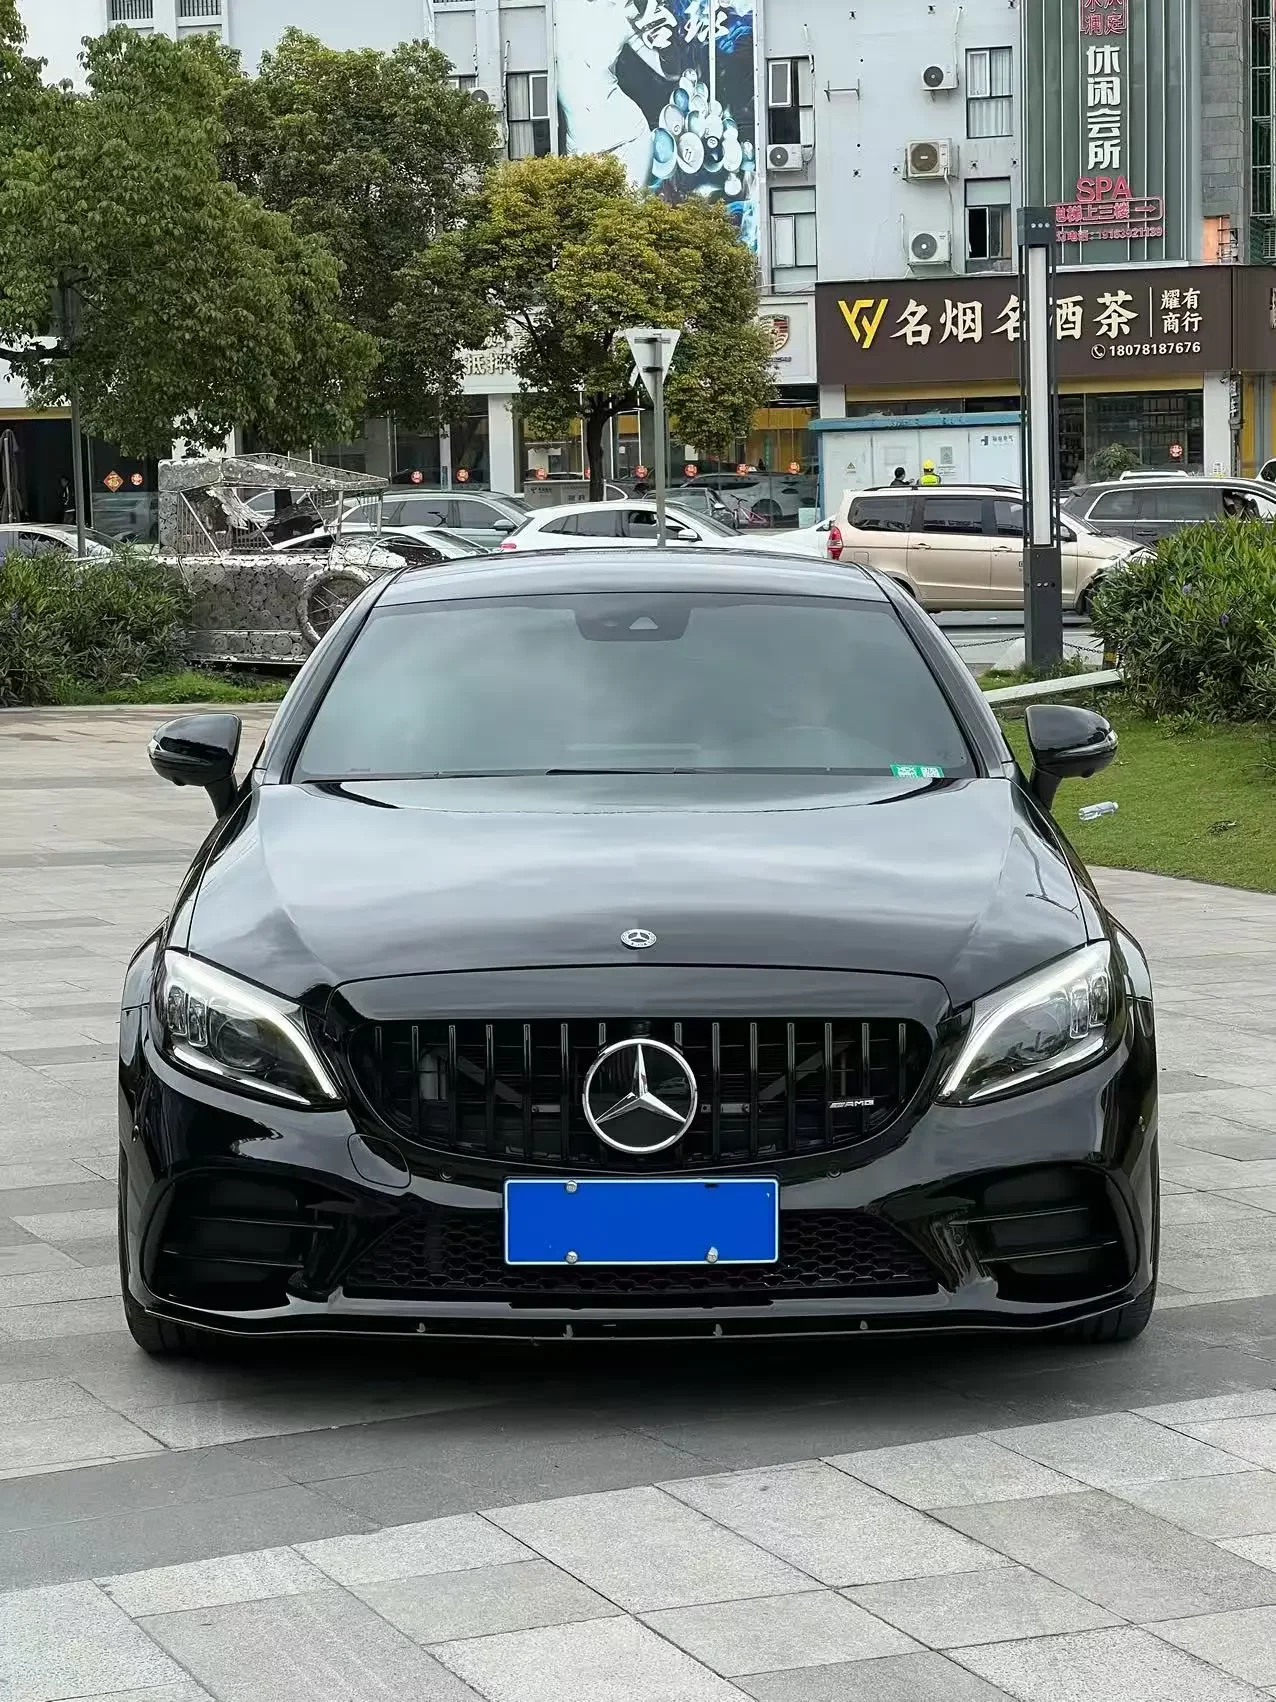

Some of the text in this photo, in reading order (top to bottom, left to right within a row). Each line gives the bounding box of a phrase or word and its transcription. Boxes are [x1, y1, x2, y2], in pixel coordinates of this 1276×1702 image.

[1086, 44, 1121, 171] 休闲会所
[1076, 175, 1135, 203] SPA
[1160, 287, 1201, 310] 耀有
[889, 289, 1139, 347] 名烟名酒茶
[1161, 311, 1203, 335] 商行
[1109, 341, 1201, 357] 18078187676
